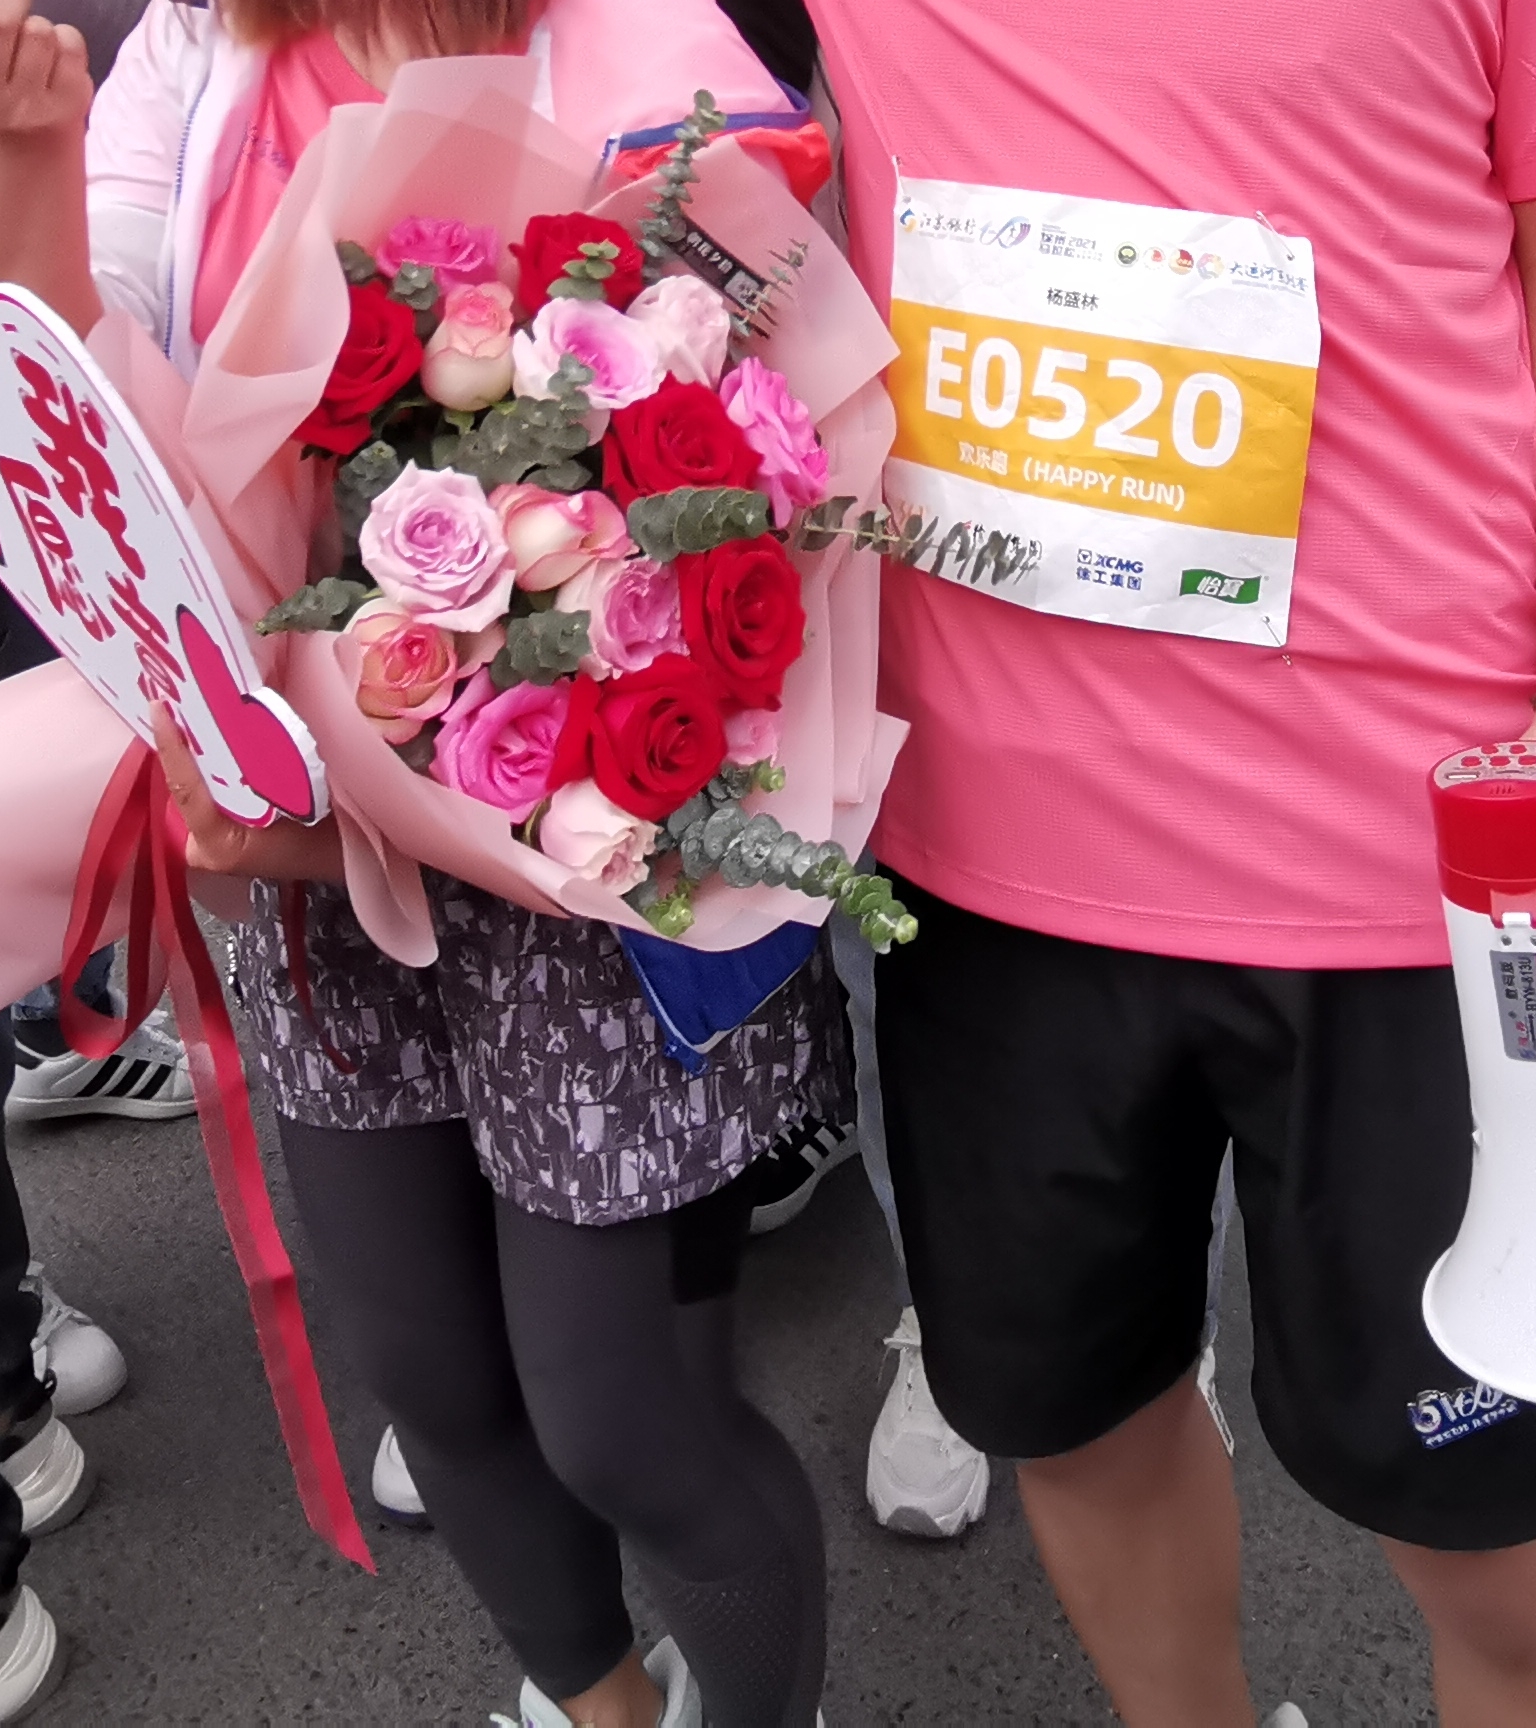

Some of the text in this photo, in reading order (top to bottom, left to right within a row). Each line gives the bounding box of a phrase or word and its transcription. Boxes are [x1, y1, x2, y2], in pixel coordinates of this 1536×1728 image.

[1046, 286, 1100, 312] 杨盛林
[925, 326, 1244, 468] E0520
